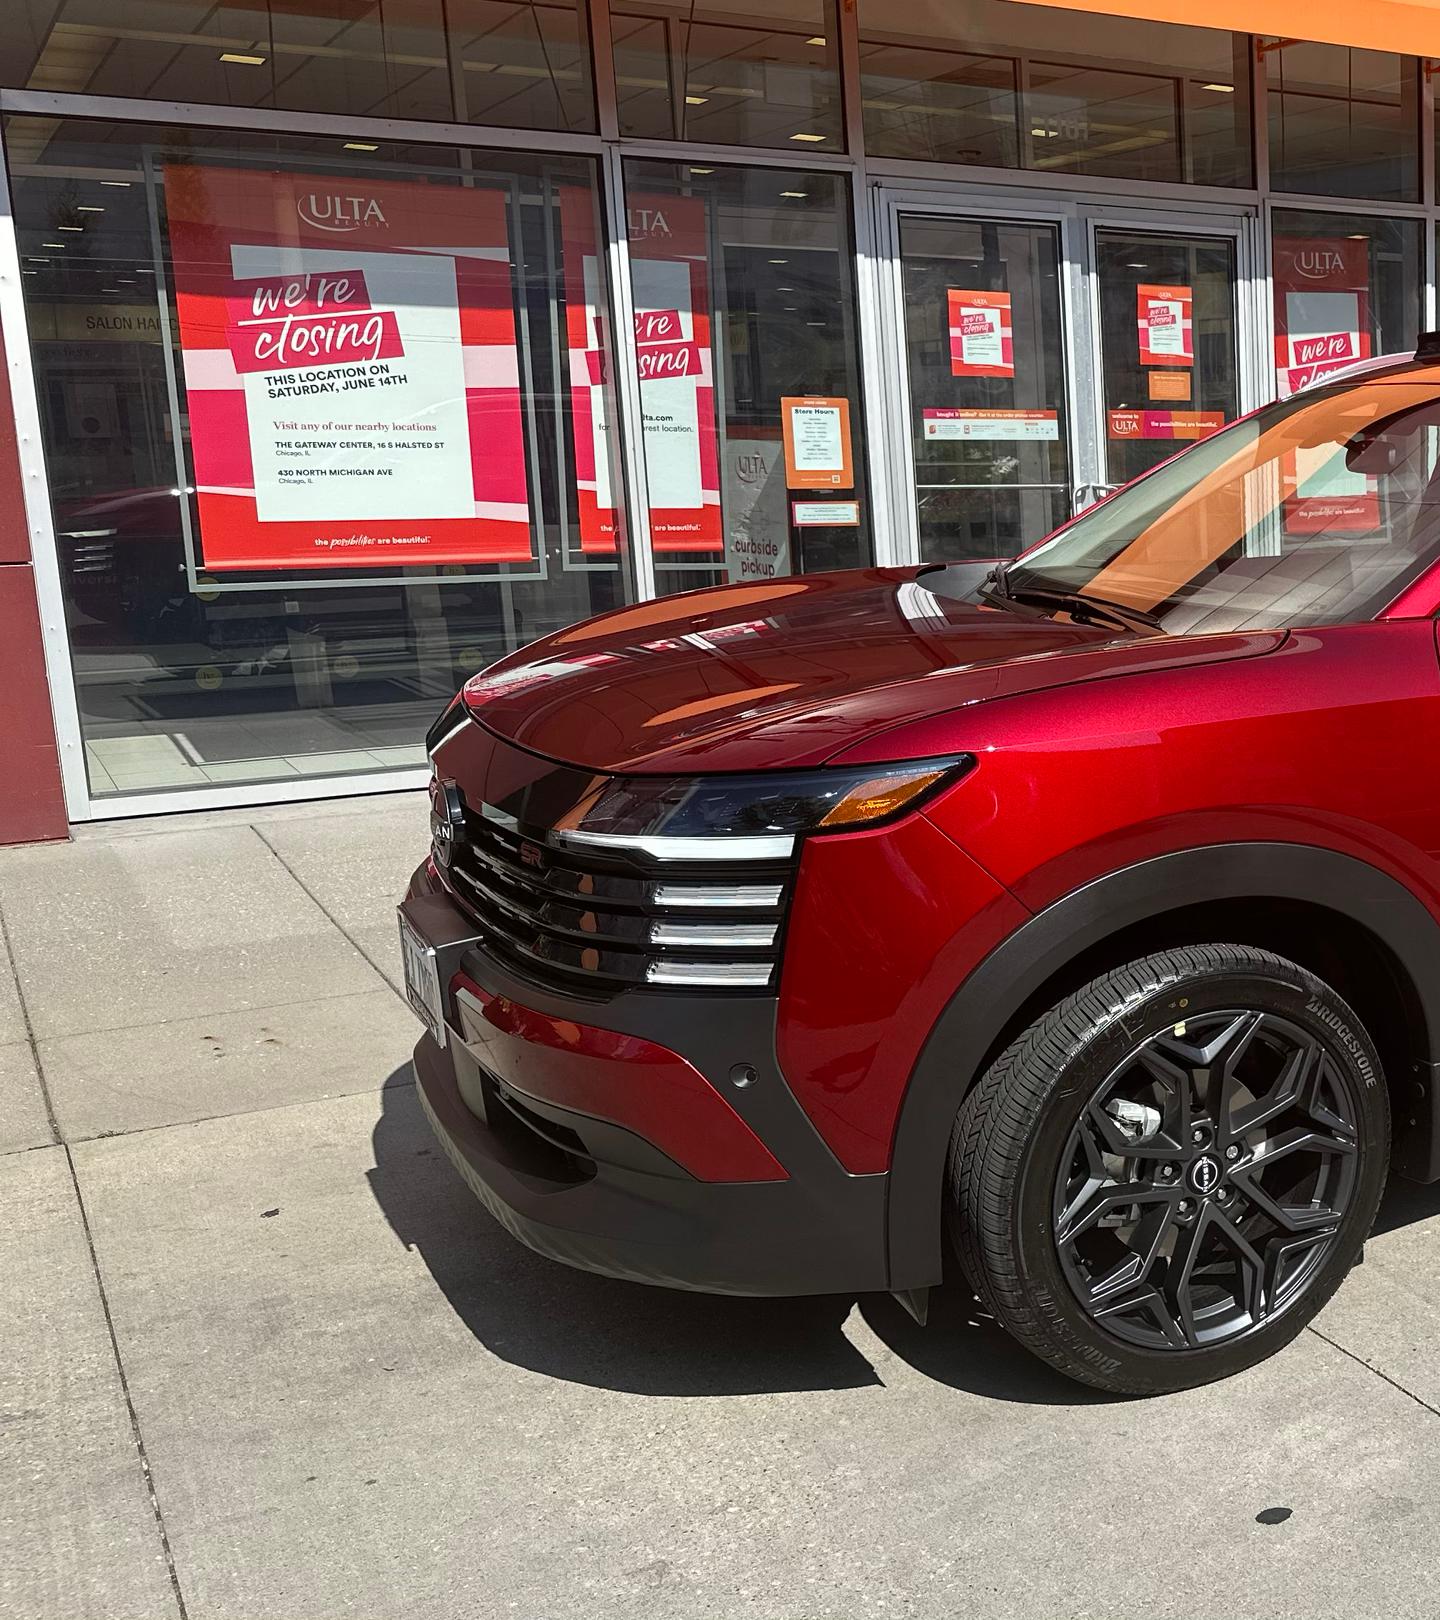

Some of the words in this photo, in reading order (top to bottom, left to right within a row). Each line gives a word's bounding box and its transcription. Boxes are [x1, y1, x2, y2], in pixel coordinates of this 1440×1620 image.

[309, 194, 386, 222] ULTA
[628, 209, 670, 233] LTA
[1301, 251, 1345, 270] ULTA
[252, 272, 356, 317] we're
[86, 315, 133, 330] SALON
[137, 316, 161, 331] HAI
[254, 313, 384, 364] closing
[1301, 334, 1347, 363] we're
[639, 347, 690, 378] sing
[264, 374, 296, 387] THIS
[298, 366, 367, 383] LOCATION
[369, 364, 390, 375] ON
[267, 382, 340, 399] SATURDAY,
[342, 377, 376, 392] JUNE
[378, 374, 408, 388] 14TH
[273, 421, 298, 431] Visit
[300, 423, 320, 432] any
[322, 421, 334, 431] of
[334, 423, 353, 431] our
[355, 421, 389, 433] nearby
[392, 421, 437, 432] locations
[642, 413, 674, 422] lta.com
[1115, 420, 1138, 430] ULTA
[598, 423, 610, 431] for
[661, 424, 694, 433] location.
[275, 441, 292, 449] THE
[294, 441, 337, 449] GATEWAY
[339, 441, 376, 451] CENTER,
[395, 441, 433, 449] HALSTED
[434, 441, 445, 449] ST
[738, 455, 769, 475] ULTA
[315, 538, 329, 546] the
[377, 537, 391, 545] are
[735, 539, 778, 556] curbside
[741, 557, 775, 578] pickup
[1305, 994, 1377, 1089] BRIDGESTONE
